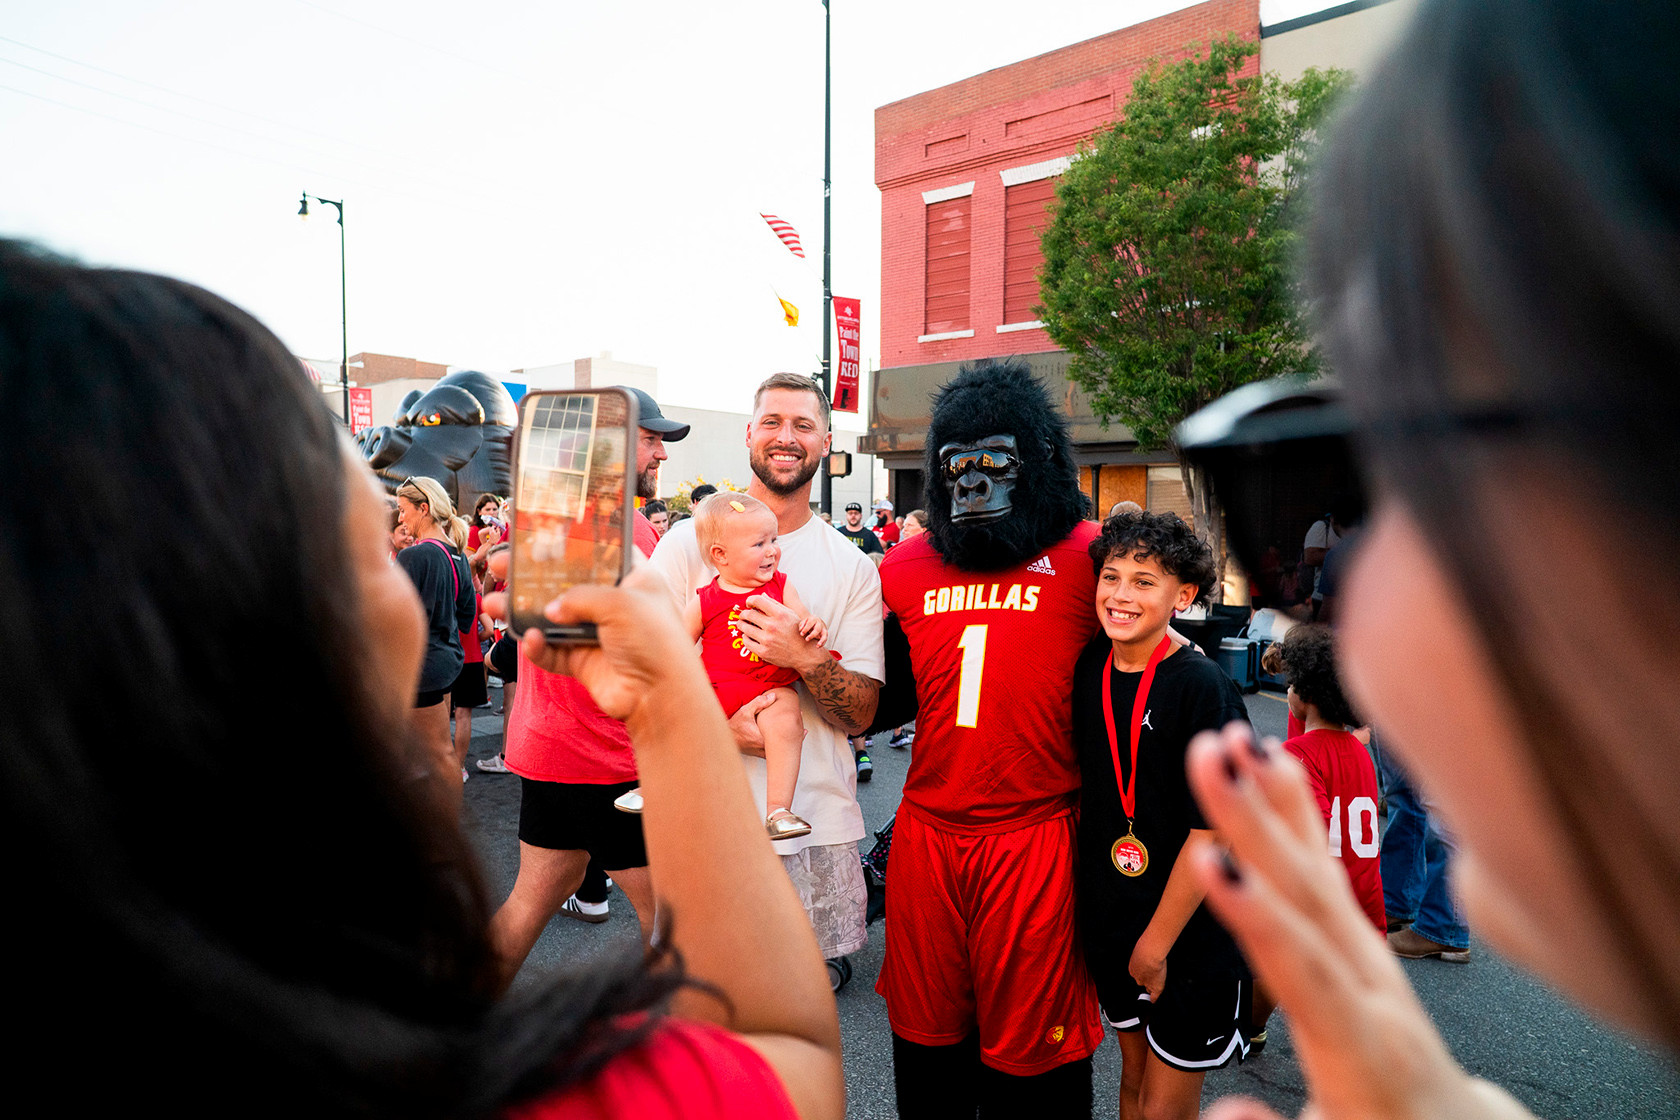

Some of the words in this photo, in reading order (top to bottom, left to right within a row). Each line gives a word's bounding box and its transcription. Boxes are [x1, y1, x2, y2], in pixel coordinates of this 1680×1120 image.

[841, 362, 858, 378] RED
[1027, 565, 1056, 576] adidas
[923, 583, 1041, 616] GORILLAS
[956, 624, 988, 729] 1
[1328, 796, 1379, 858] 10
